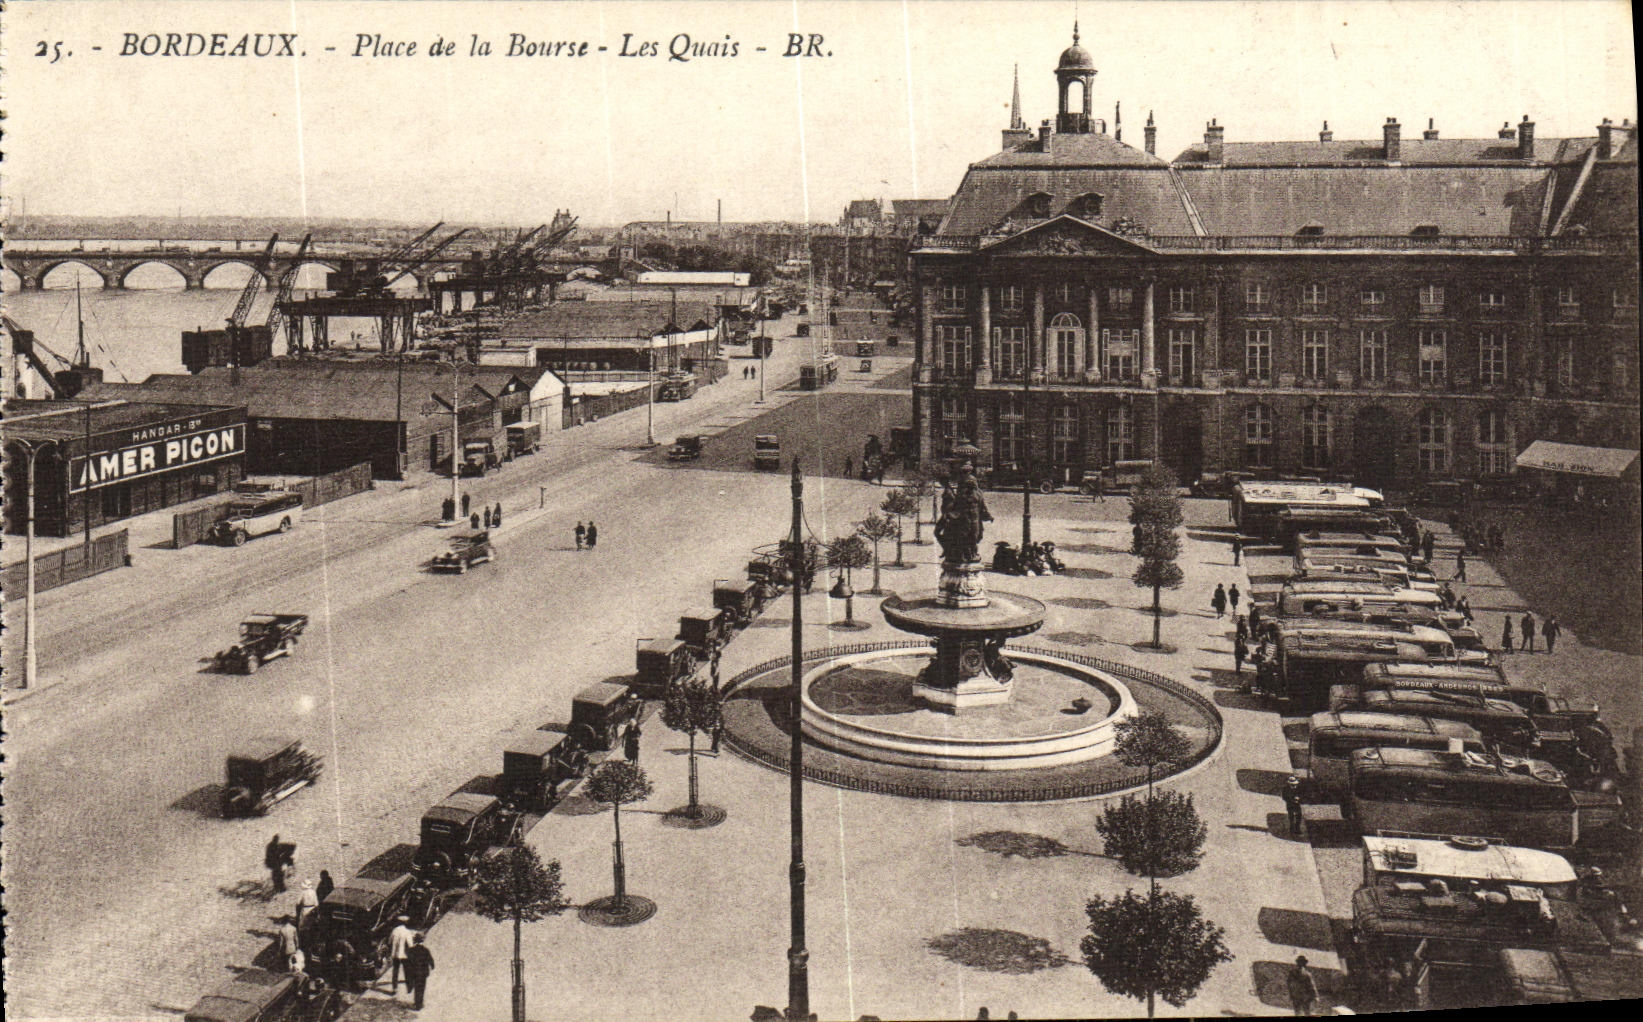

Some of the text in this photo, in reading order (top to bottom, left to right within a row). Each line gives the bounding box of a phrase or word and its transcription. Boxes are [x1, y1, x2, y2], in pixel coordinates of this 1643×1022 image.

[132, 423, 181, 442] HANGAR
[79, 429, 235, 486] AMER PICON
